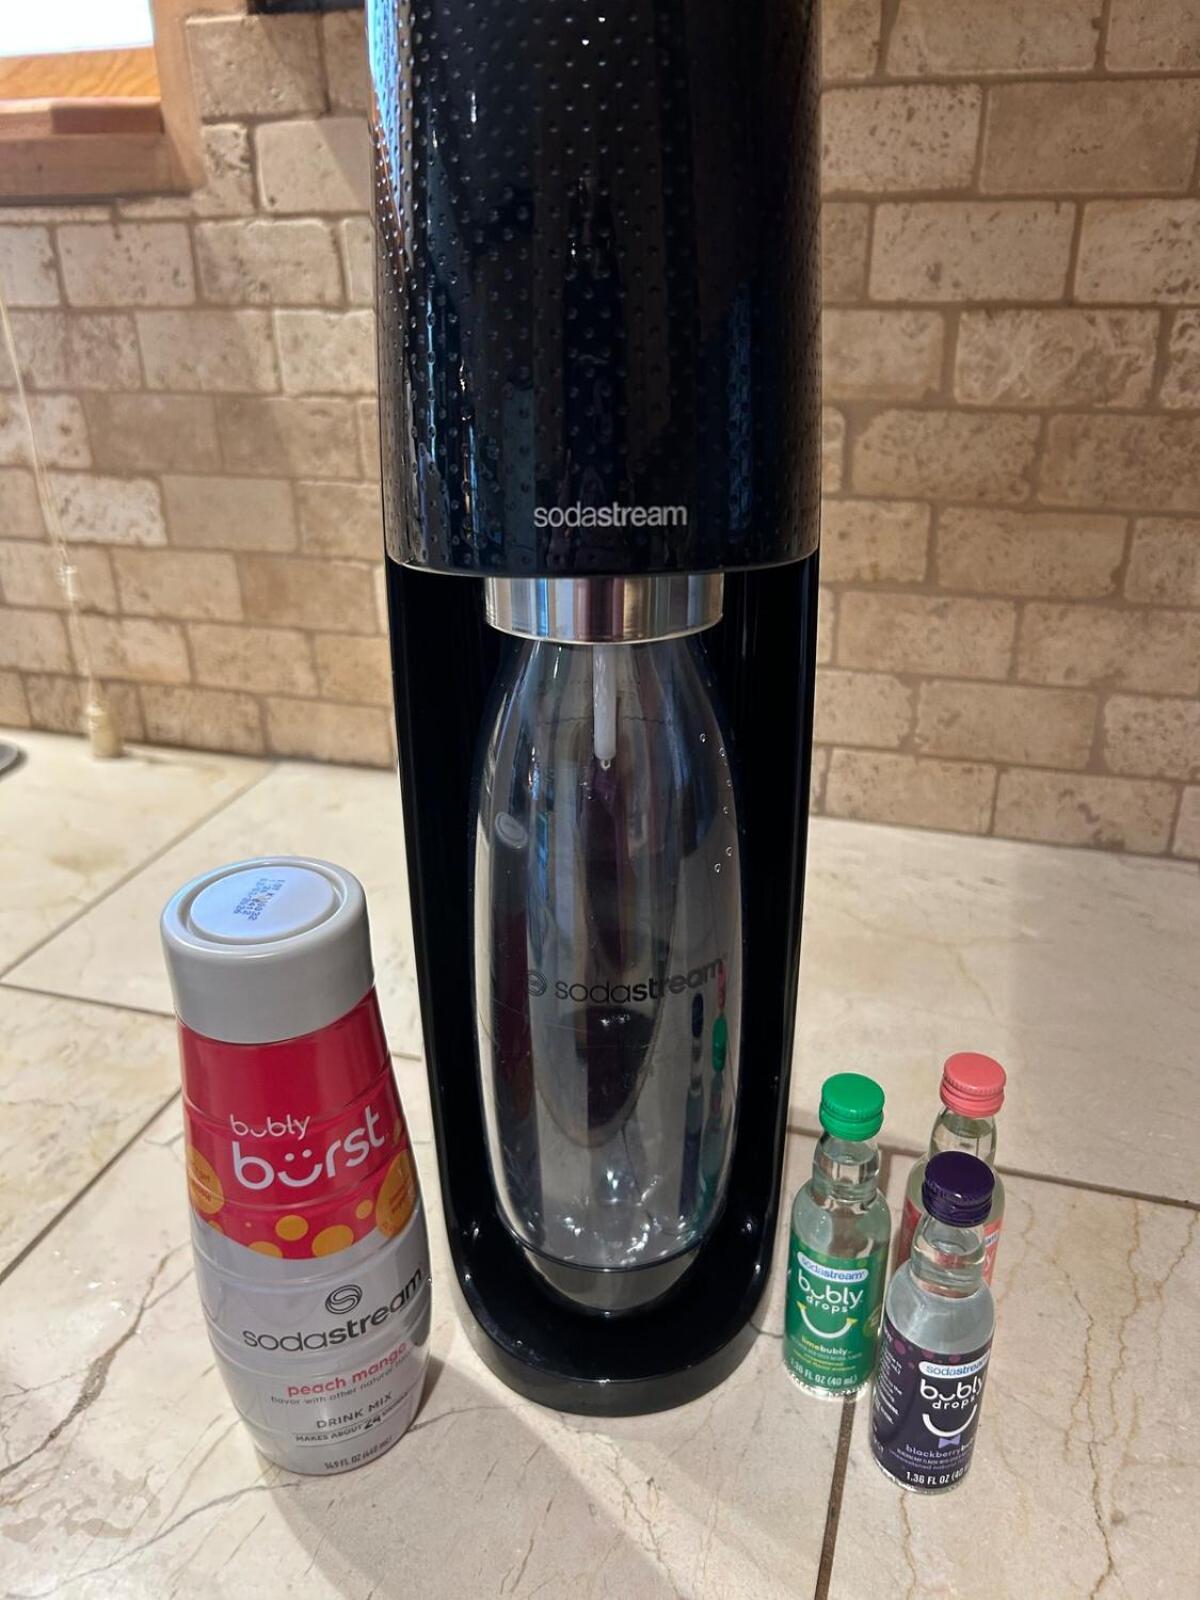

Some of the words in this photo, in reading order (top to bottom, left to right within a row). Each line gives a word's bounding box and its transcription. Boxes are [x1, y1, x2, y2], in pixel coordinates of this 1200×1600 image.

[533, 501, 687, 527] sodastream
[554, 958, 724, 1004] sodastream
[229, 1113, 311, 1141] bubly
[797, 1255, 865, 1280] sodastream
[798, 1268, 864, 1309] bubly
[242, 1268, 422, 1351] sodastream
[806, 1295, 849, 1314] drops
[287, 1376, 346, 1398] peach
[351, 1342, 408, 1384] mango
[919, 1375, 983, 1401] bubly
[316, 1408, 364, 1429] DRINK
[368, 1391, 392, 1412] MIX
[295, 1433, 328, 1442] MAKES
[330, 1424, 362, 1439] ABOUT
[906, 1471, 925, 1484] 1.36
[927, 1476, 937, 1485] FL
[939, 1474, 950, 1484] OZ
